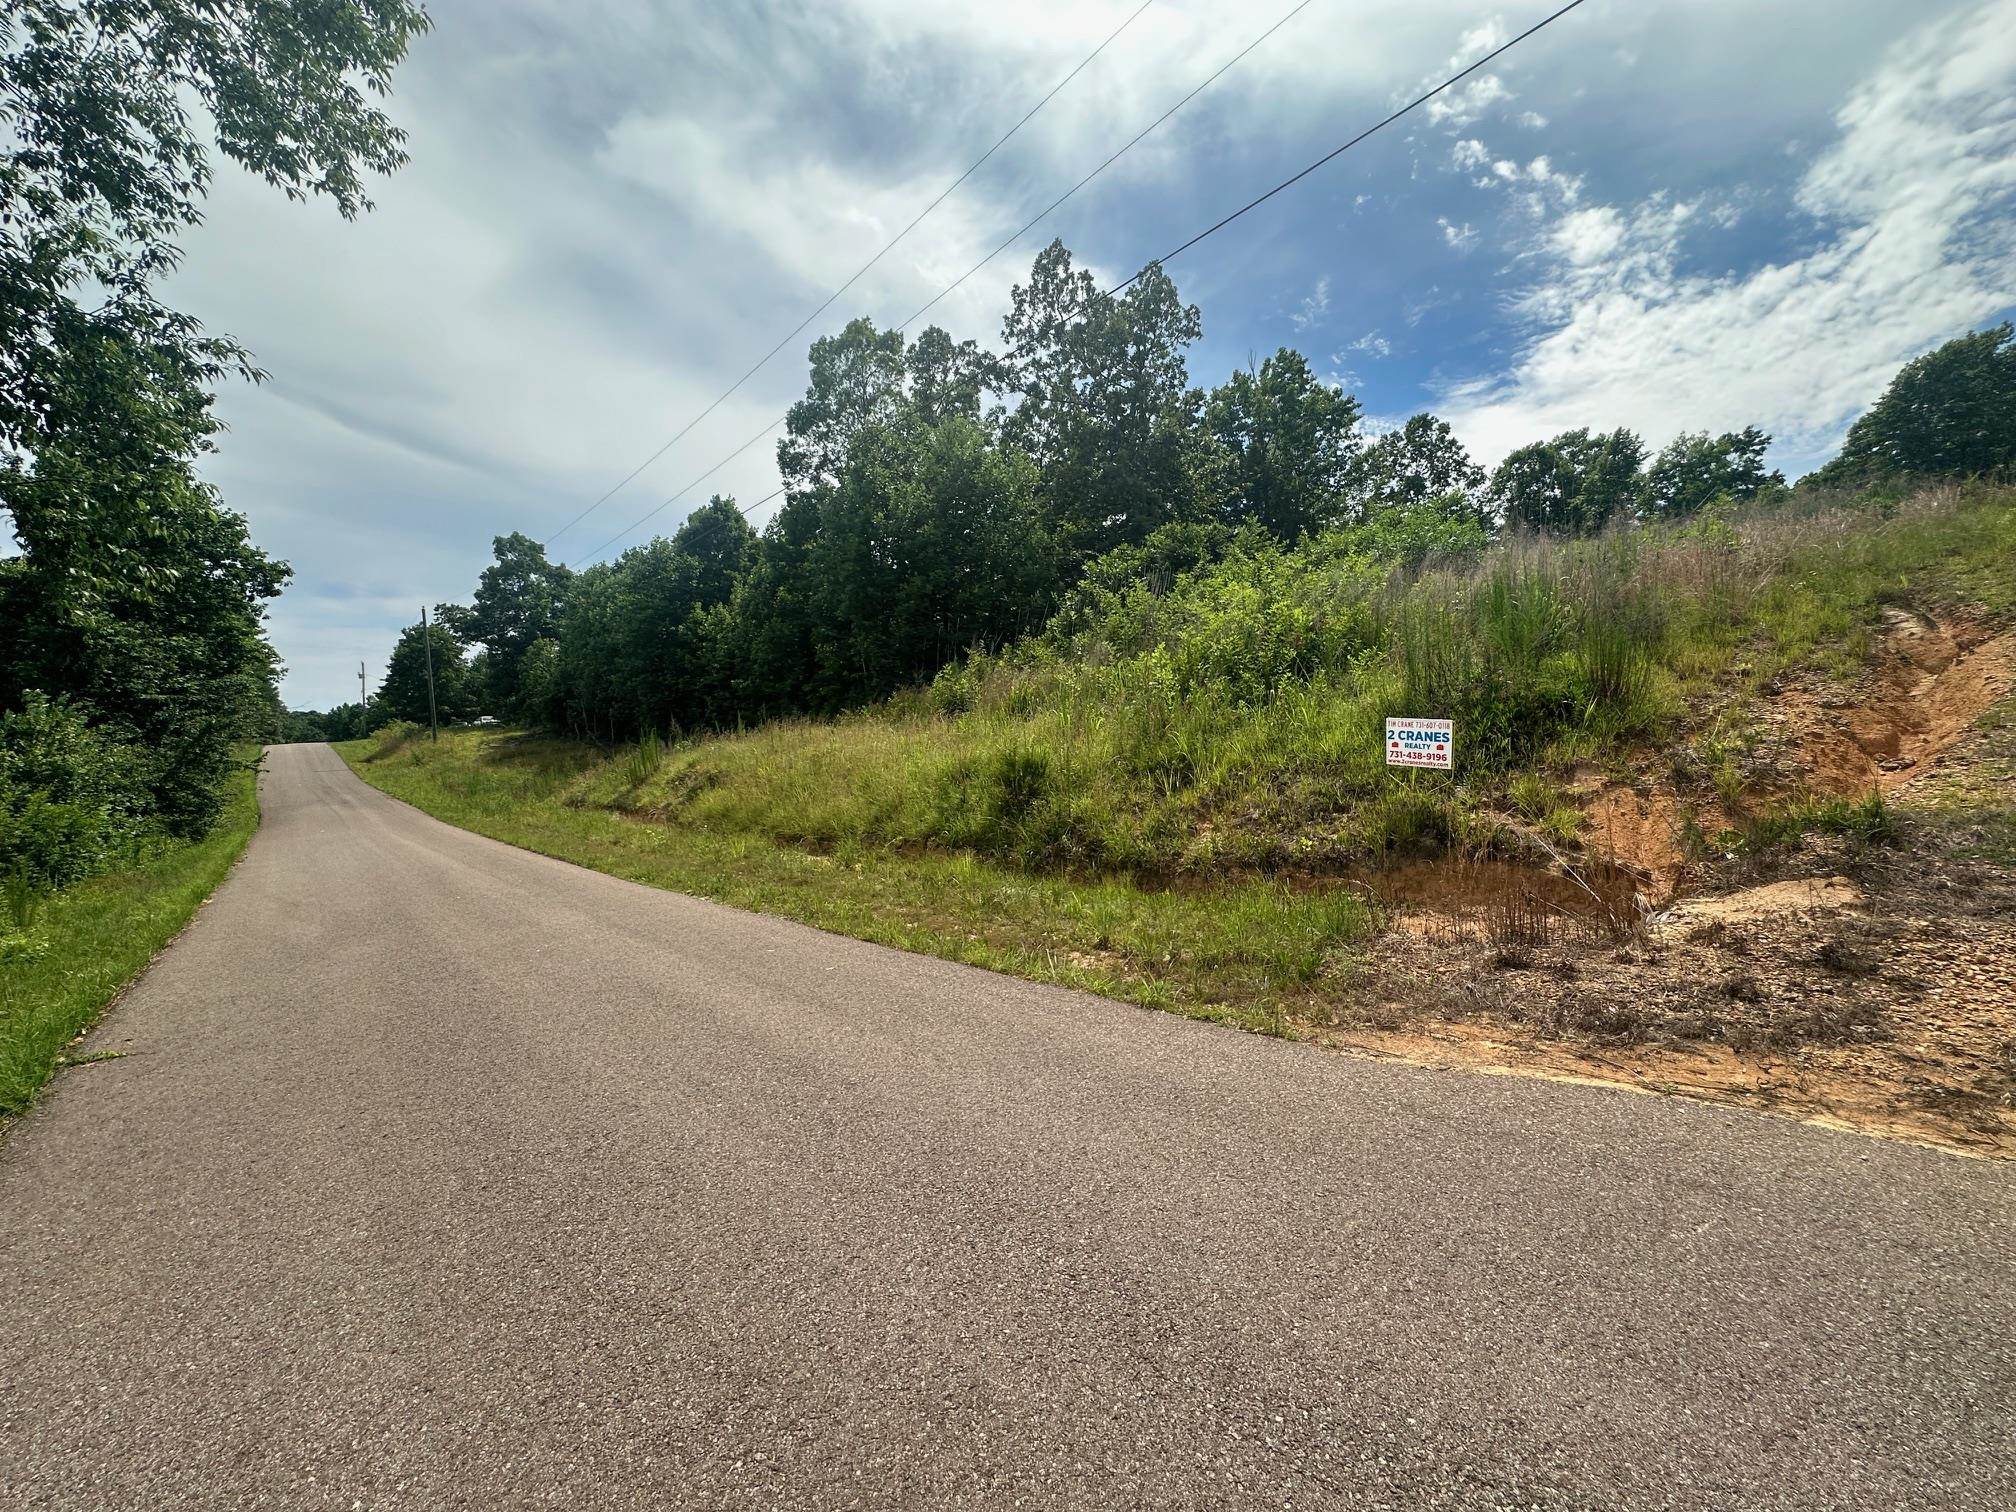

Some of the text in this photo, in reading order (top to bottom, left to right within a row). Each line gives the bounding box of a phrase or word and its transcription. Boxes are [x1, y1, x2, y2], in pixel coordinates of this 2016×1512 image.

[1388, 730, 1450, 742] 2 CRANES
[1390, 750, 1447, 762] 731-438-9196
[1388, 759, 1448, 768] www.2cranesrealty.com
